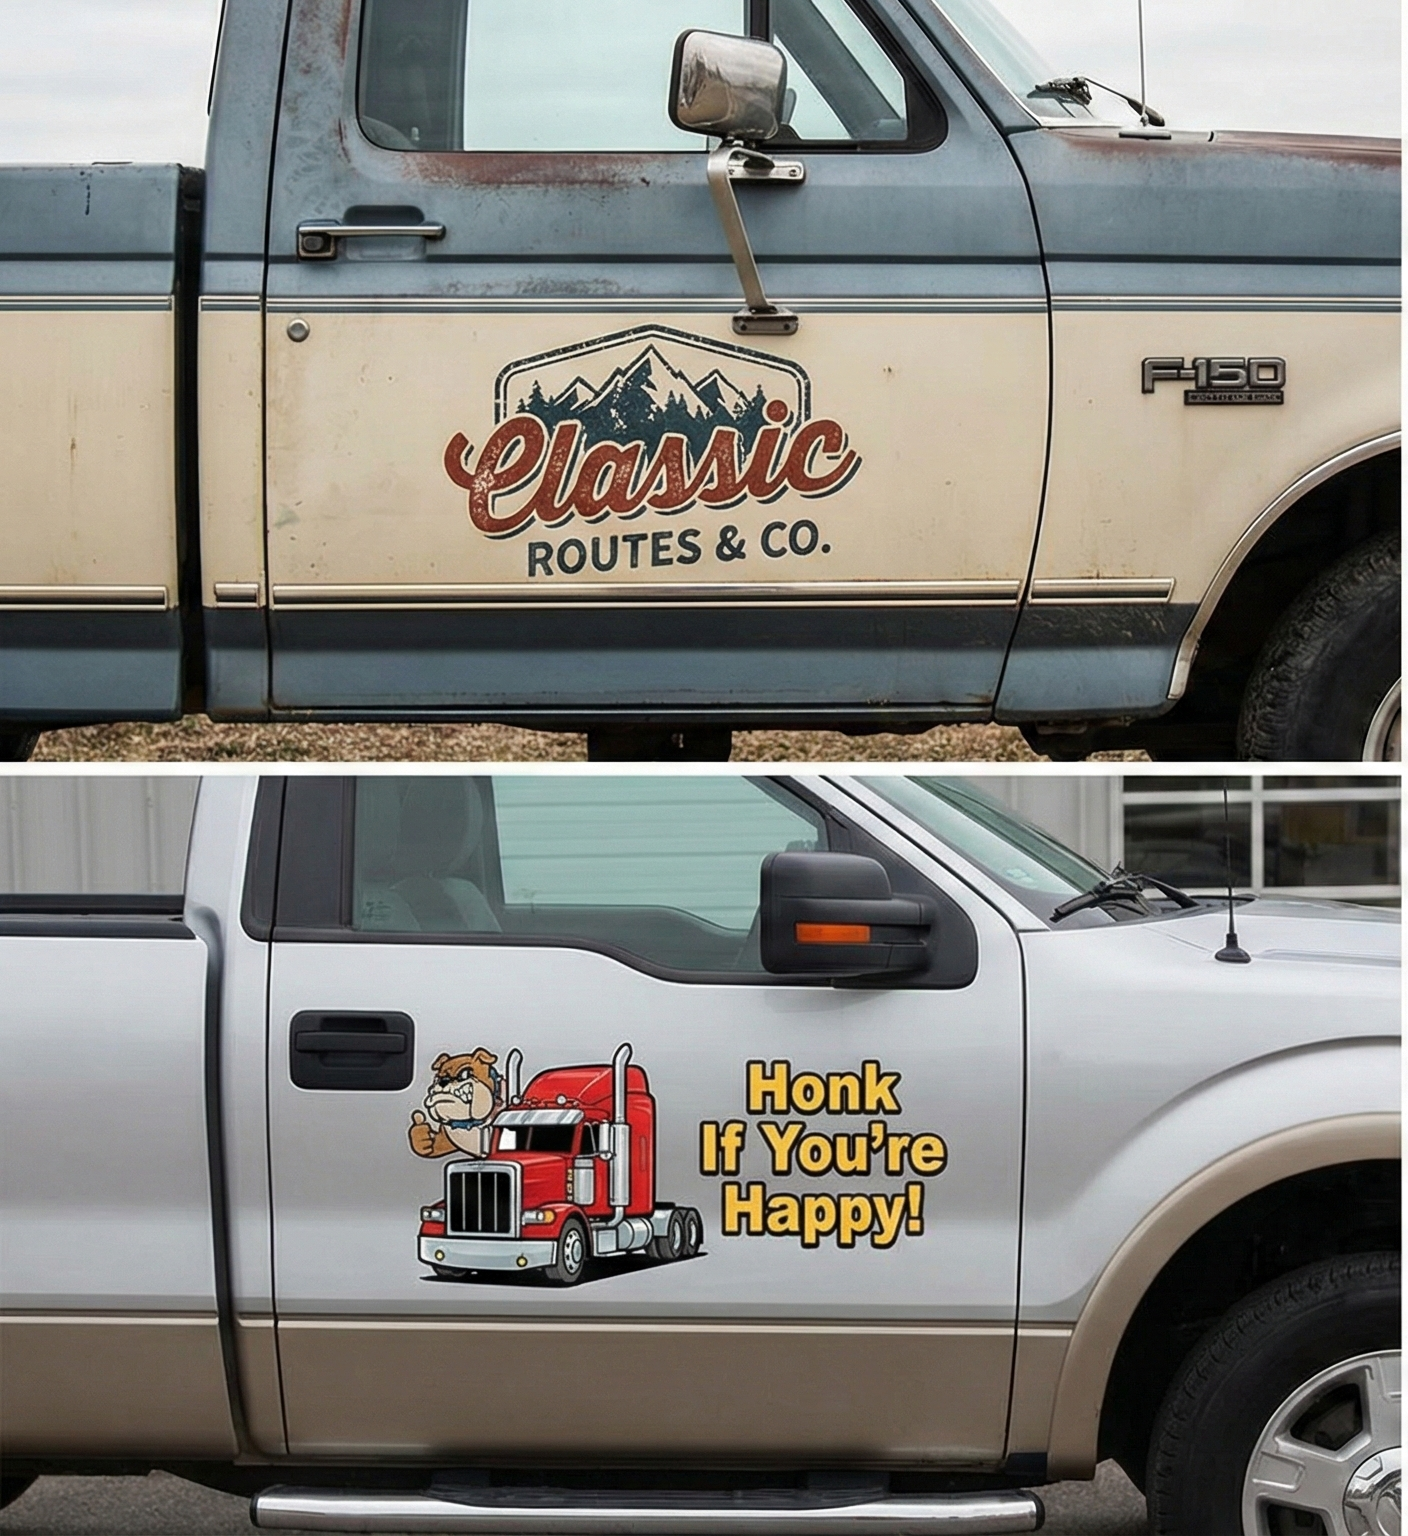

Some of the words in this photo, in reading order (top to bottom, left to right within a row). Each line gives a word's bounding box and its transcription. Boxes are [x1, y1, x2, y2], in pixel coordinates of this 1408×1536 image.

[1142, 357, 1286, 394] F-150
[443, 399, 863, 540] Classic
[527, 528, 703, 578] ROUTES
[715, 525, 747, 562] &
[760, 519, 832, 558] CO.
[746, 1060, 902, 1115] Honk
[700, 1119, 747, 1176] If
[757, 1120, 948, 1177] You're
[721, 1181, 925, 1249] Happy!
